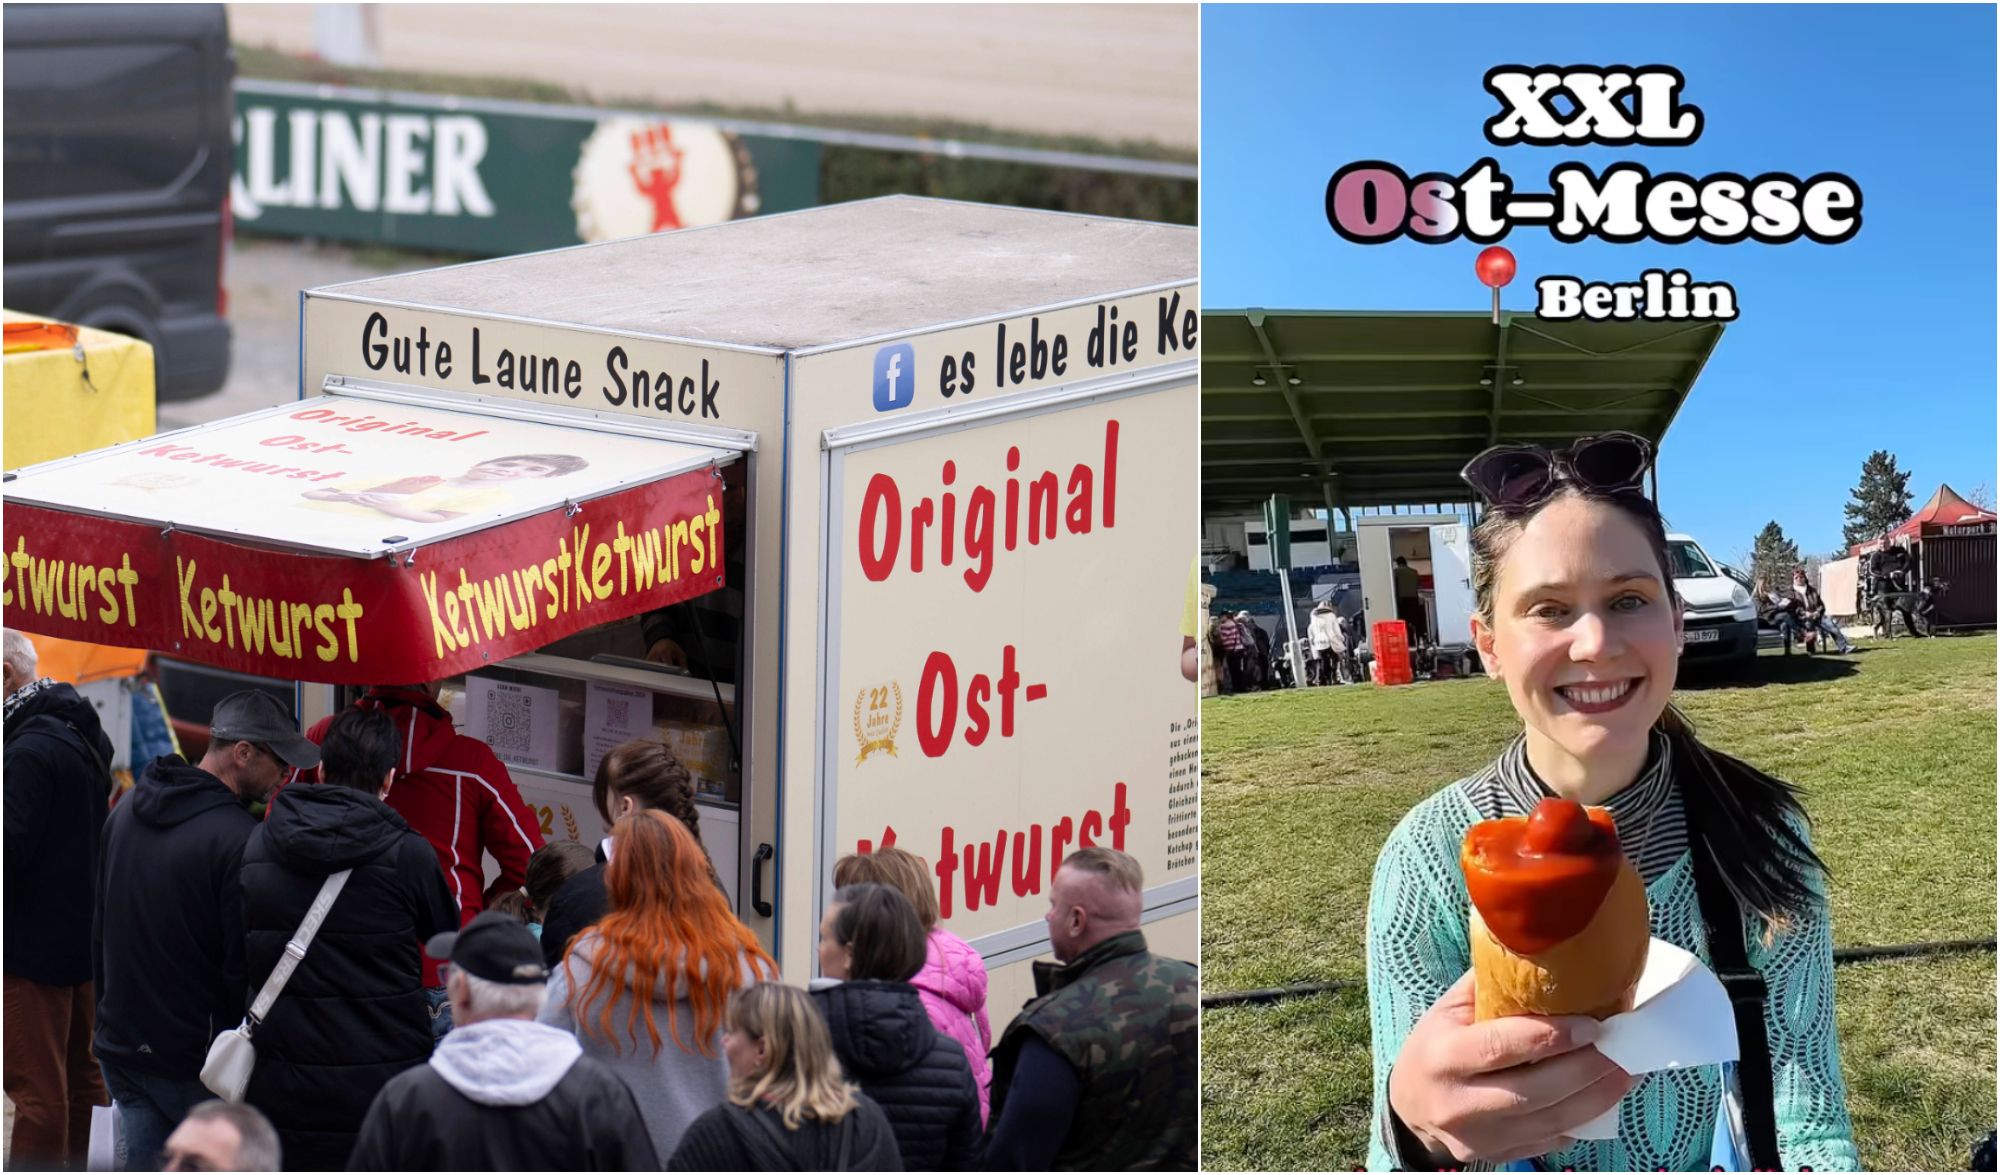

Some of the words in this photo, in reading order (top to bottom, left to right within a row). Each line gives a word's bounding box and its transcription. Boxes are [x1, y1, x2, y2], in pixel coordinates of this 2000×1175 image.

[939, 351, 976, 398] es
[996, 317, 1069, 388] lebe
[1087, 304, 1138, 368] die
[1157, 291, 1198, 355] Ke
[361, 311, 453, 379] Gute
[471, 326, 582, 399] Laune
[602, 345, 720, 419] Snack
[257, 434, 354, 456] Ost-
[288, 408, 490, 443] Original
[138, 443, 346, 482] Ketwurst
[858, 419, 1120, 593] Original
[177, 555, 363, 663] Ketwurst
[869, 686, 888, 711] 22
[916, 645, 1048, 758] Ost-
[867, 712, 889, 729] Jahre
[1170, 722, 1180, 732] Die
[857, 782, 1130, 919] twurst
[1168, 841, 1192, 855] Ketchup
